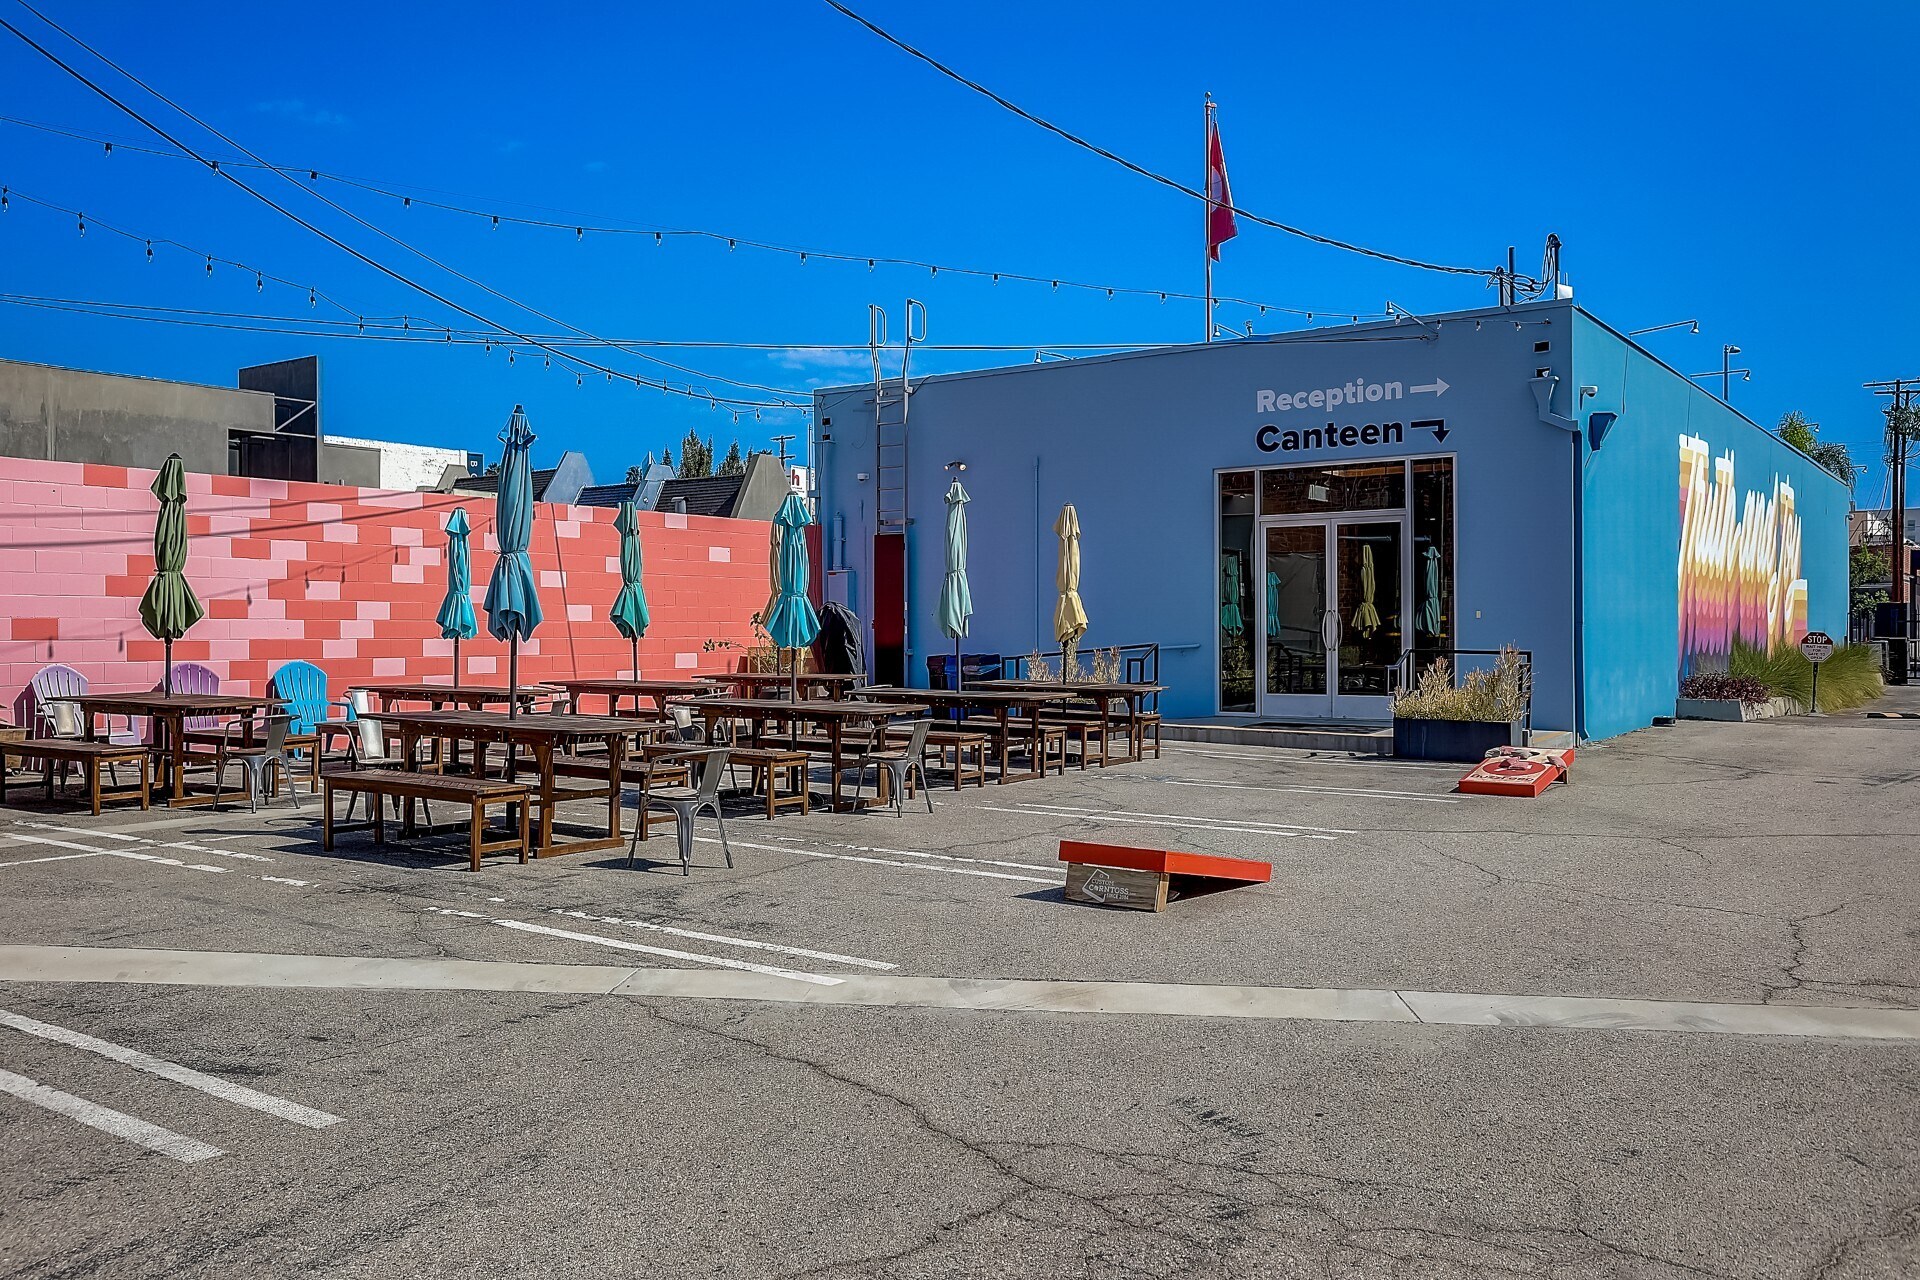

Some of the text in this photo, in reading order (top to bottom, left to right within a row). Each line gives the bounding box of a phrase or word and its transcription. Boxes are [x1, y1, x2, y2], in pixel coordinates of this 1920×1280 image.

[1256, 377, 1403, 413] Reception
[1256, 421, 1404, 453] Canteen
[1807, 635, 1828, 644] STOP
